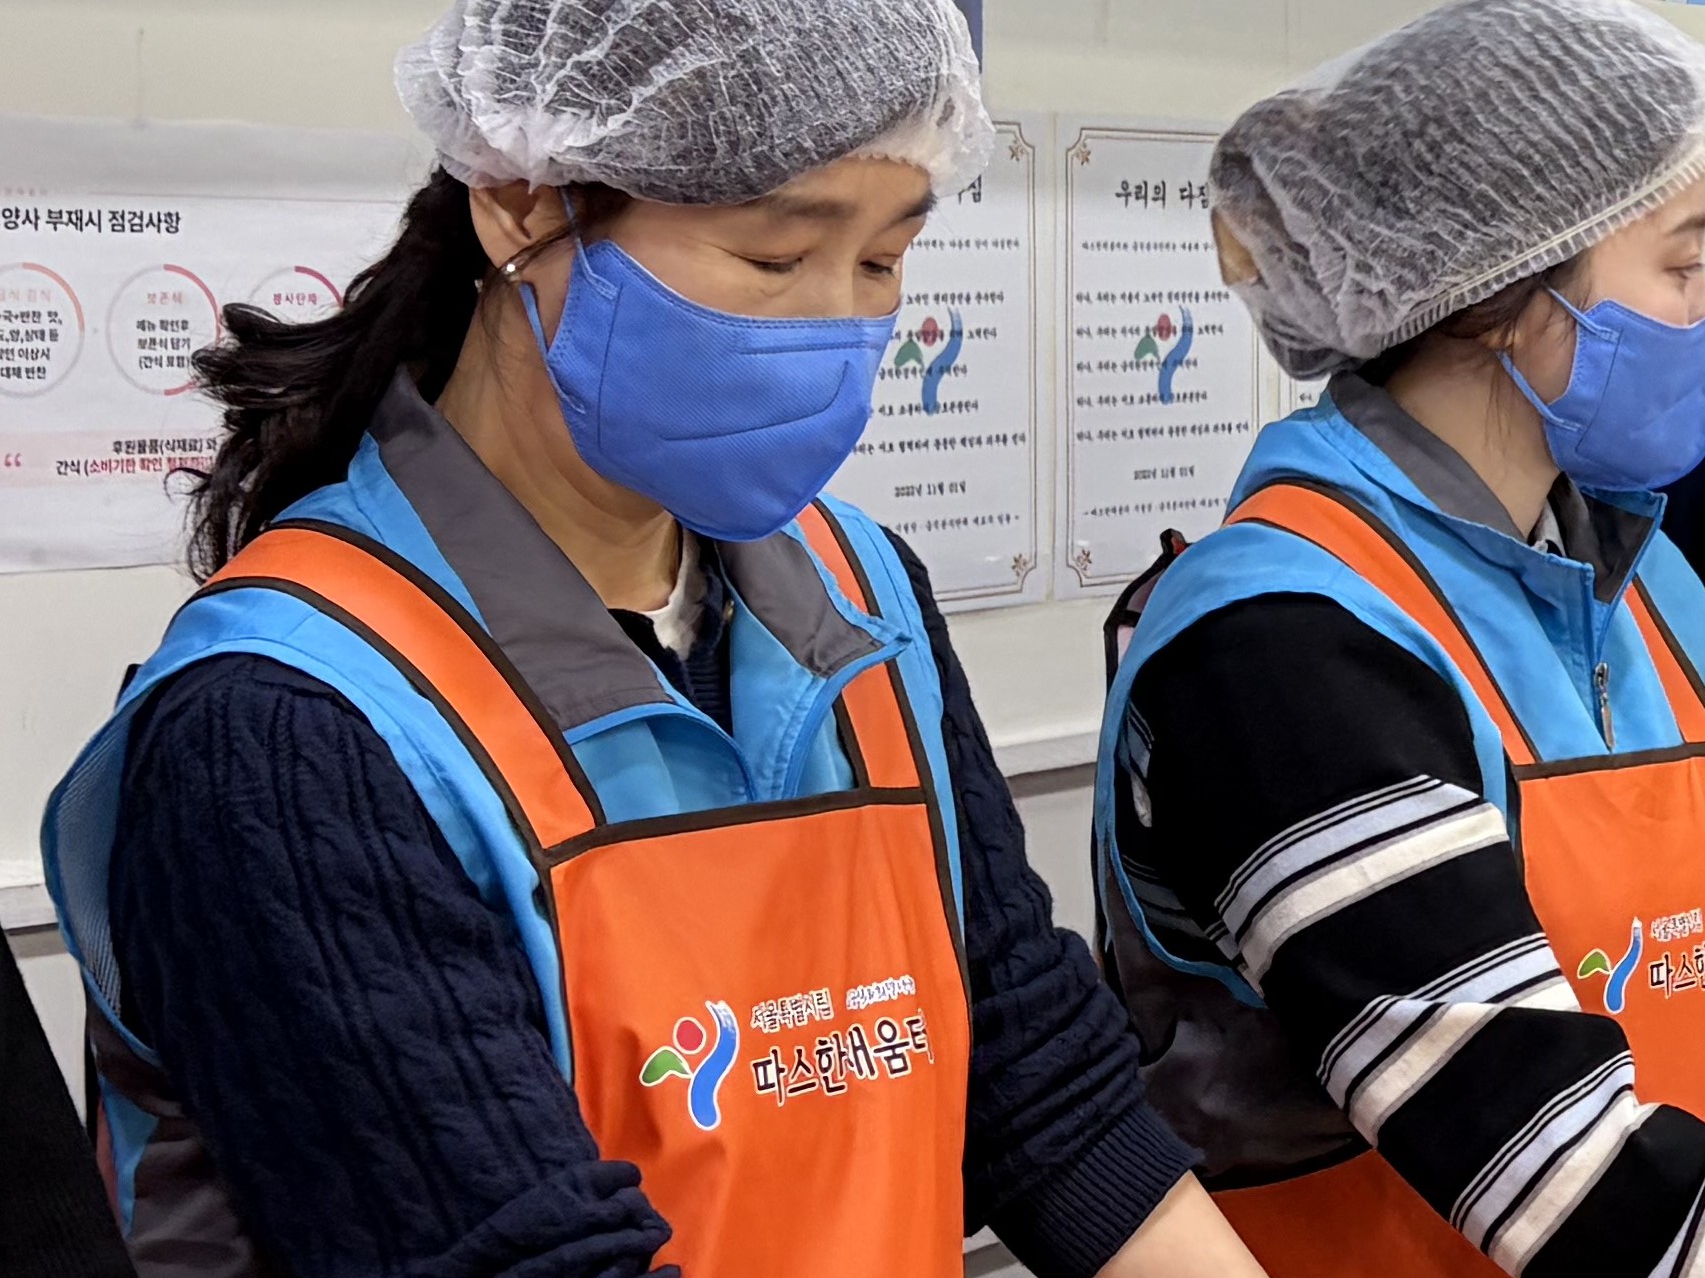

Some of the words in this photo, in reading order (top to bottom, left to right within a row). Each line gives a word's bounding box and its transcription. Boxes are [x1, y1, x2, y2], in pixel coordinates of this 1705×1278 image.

[1115, 179, 1166, 209] 우리의
[0, 206, 40, 231] 양사
[45, 208, 102, 233] 부재시
[108, 210, 181, 234] 점검사항
